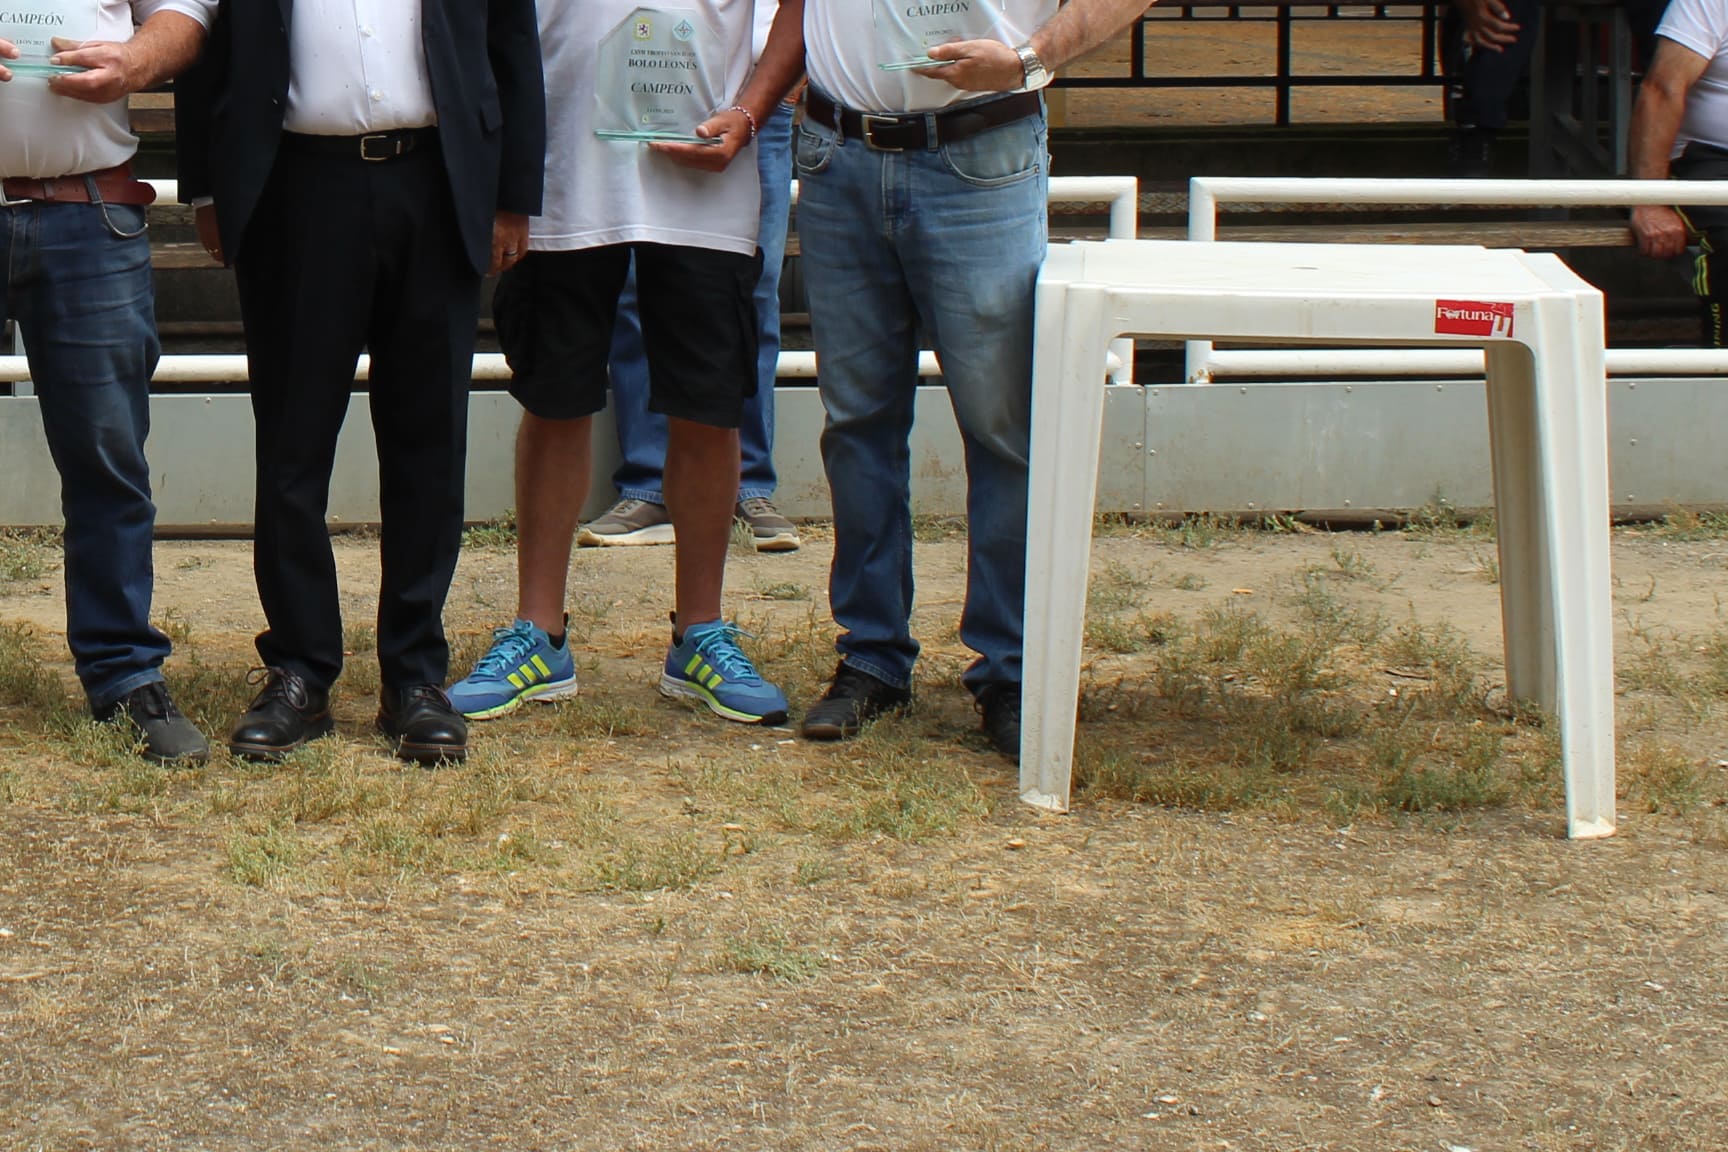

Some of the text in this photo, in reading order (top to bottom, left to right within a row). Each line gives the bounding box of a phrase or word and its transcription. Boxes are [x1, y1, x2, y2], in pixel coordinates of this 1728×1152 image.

[906, 0, 969, 17] CAMPEÓN
[0, 10, 65, 26] CAMPEÓN
[628, 58, 657, 69] BOLO
[631, 81, 694, 96] CAMPEÓN
[1437, 307, 1494, 321] Fortuna
